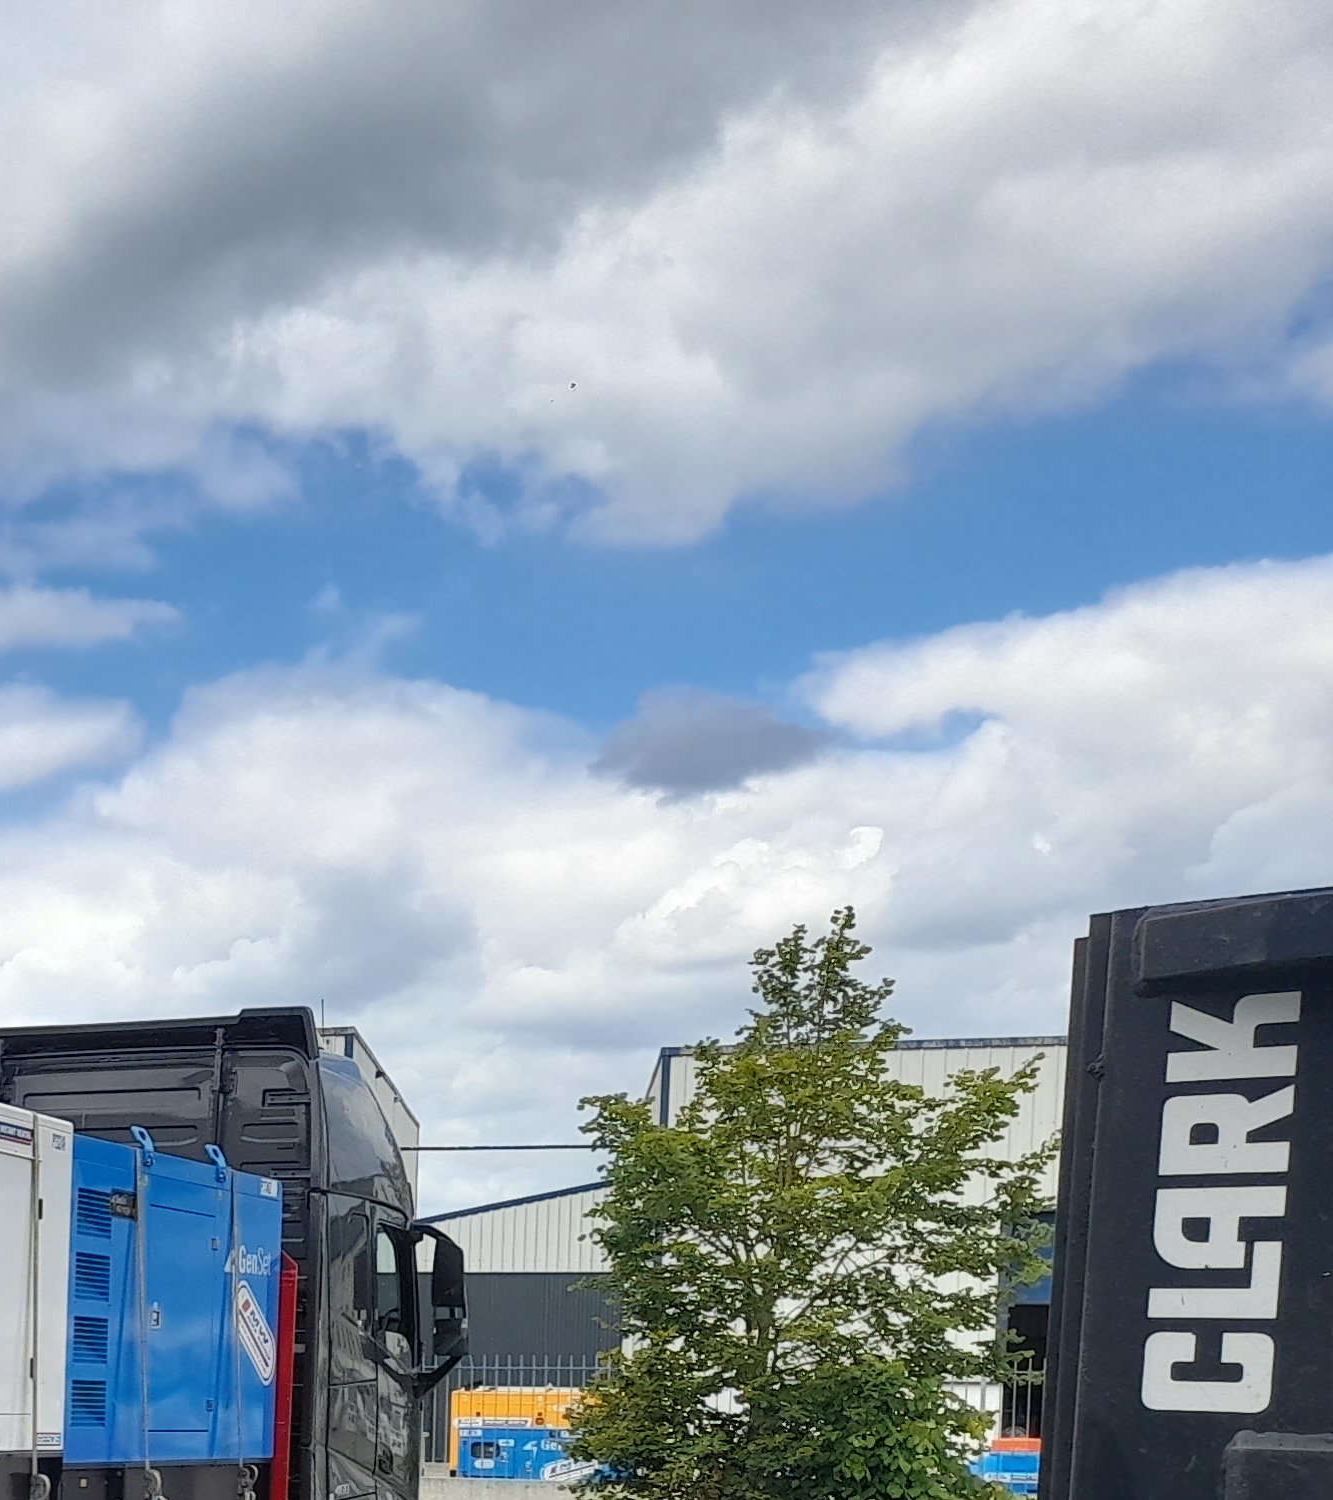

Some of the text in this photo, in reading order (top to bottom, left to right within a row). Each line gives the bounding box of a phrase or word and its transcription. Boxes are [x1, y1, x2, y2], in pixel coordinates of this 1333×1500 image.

[1141, 990, 1303, 1414] CLARK
[239, 1245, 272, 1275] GenSet
[249, 1309, 269, 1345] MW
